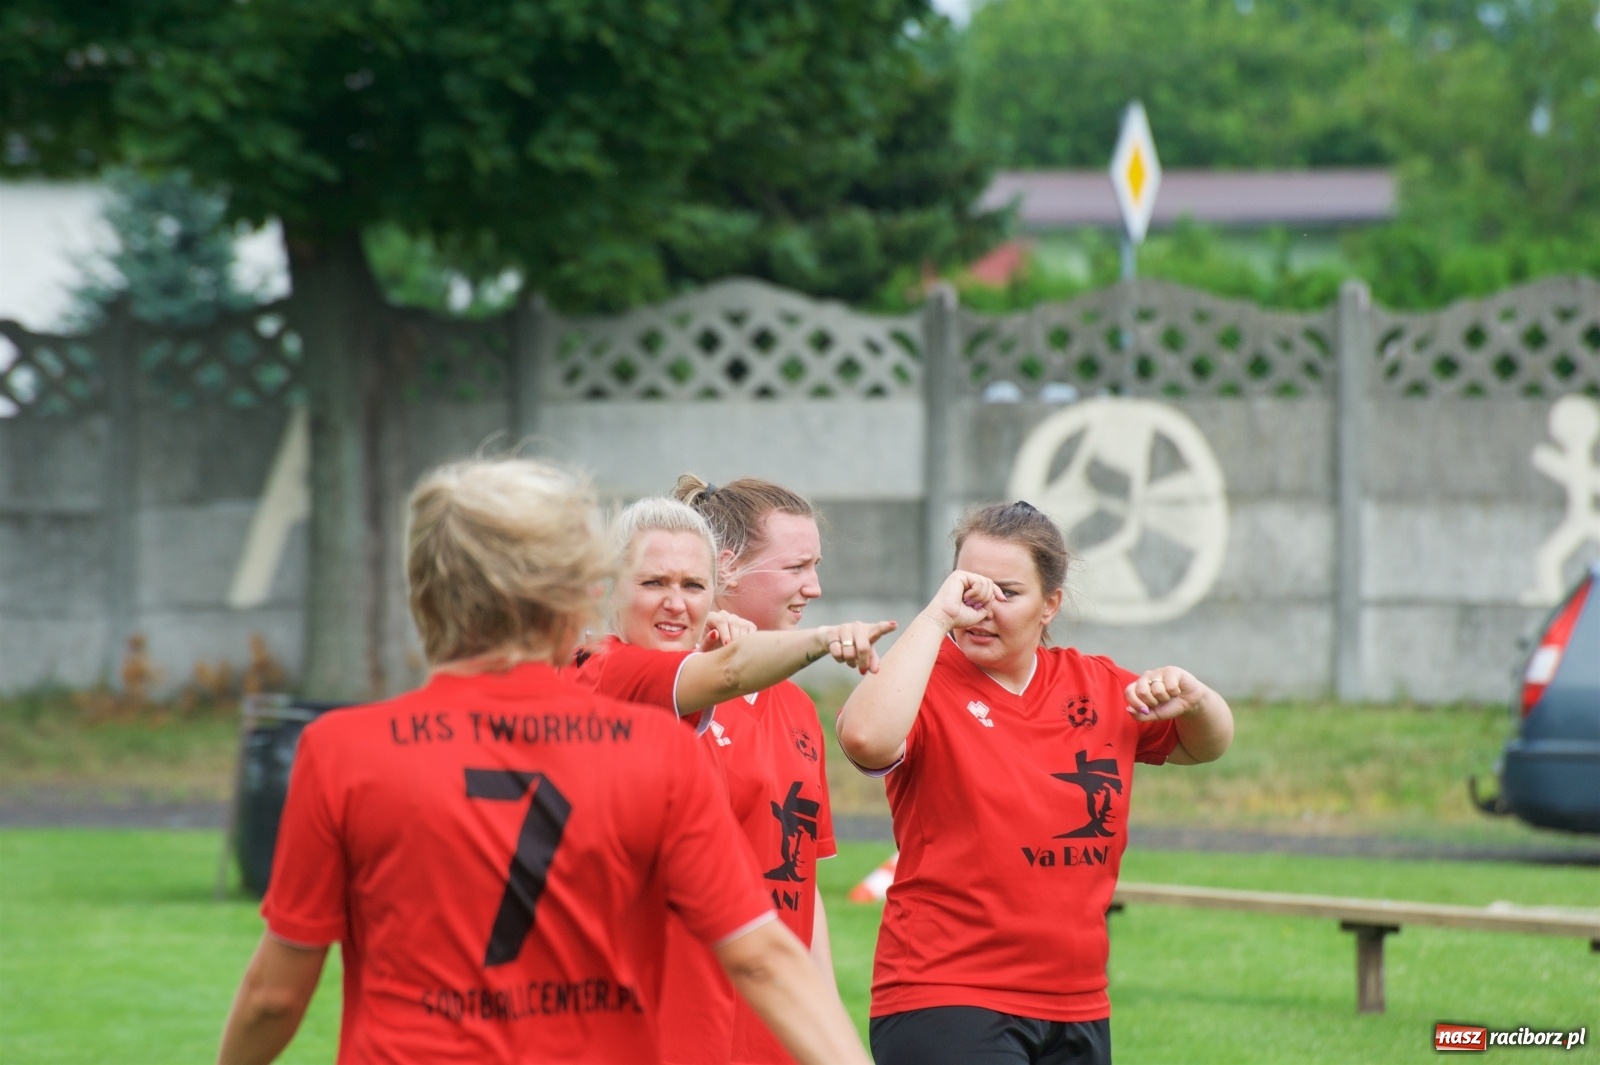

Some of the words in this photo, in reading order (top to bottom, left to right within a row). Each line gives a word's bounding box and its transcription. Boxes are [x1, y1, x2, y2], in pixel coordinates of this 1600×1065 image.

[391, 713, 454, 745] LKS
[468, 710, 633, 743] TWORKÓW
[464, 768, 572, 967] 7
[1021, 847, 1056, 868] Va
